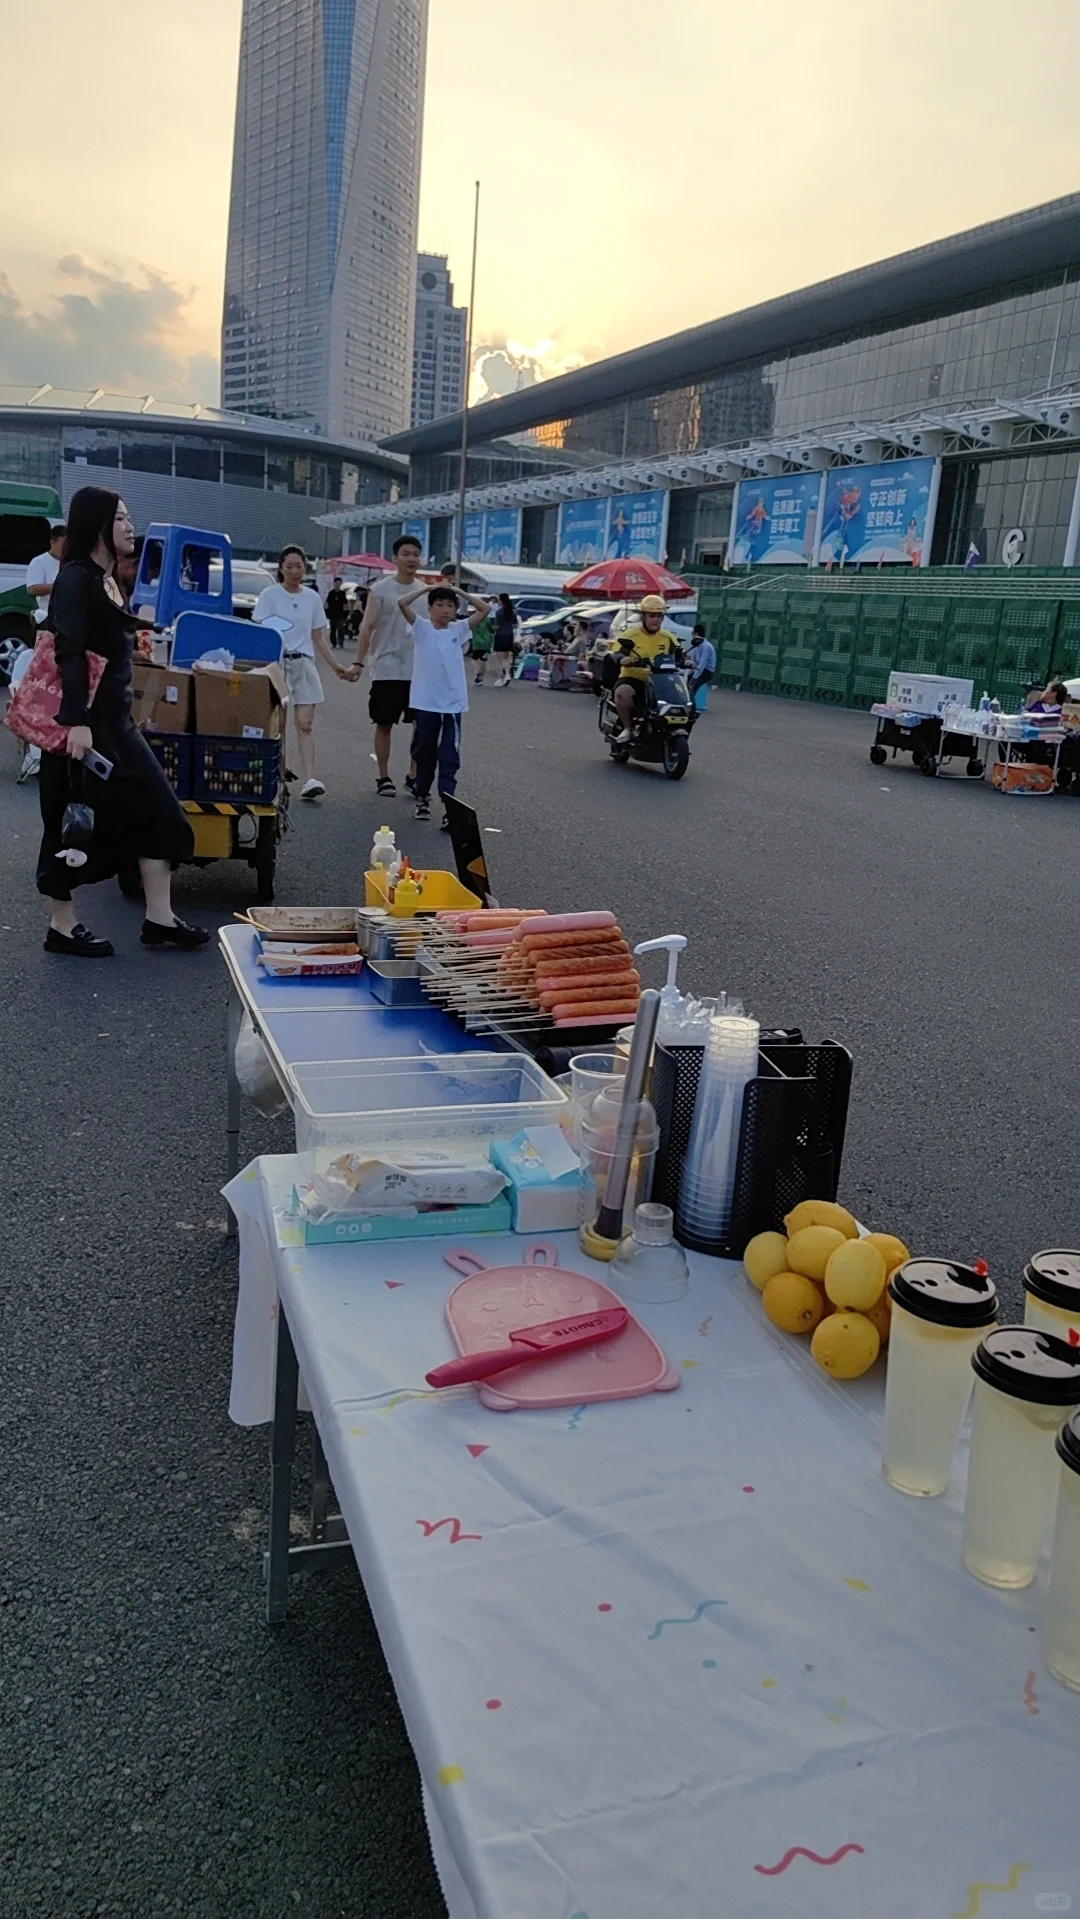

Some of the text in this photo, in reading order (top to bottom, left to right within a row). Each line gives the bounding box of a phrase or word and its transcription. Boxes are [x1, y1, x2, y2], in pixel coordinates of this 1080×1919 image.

[868, 488, 907, 507] 守正创新
[771, 500, 802, 515] 品质建工
[770, 518, 801, 533] 百年建工
[865, 509, 904, 527] 坚韧向上
